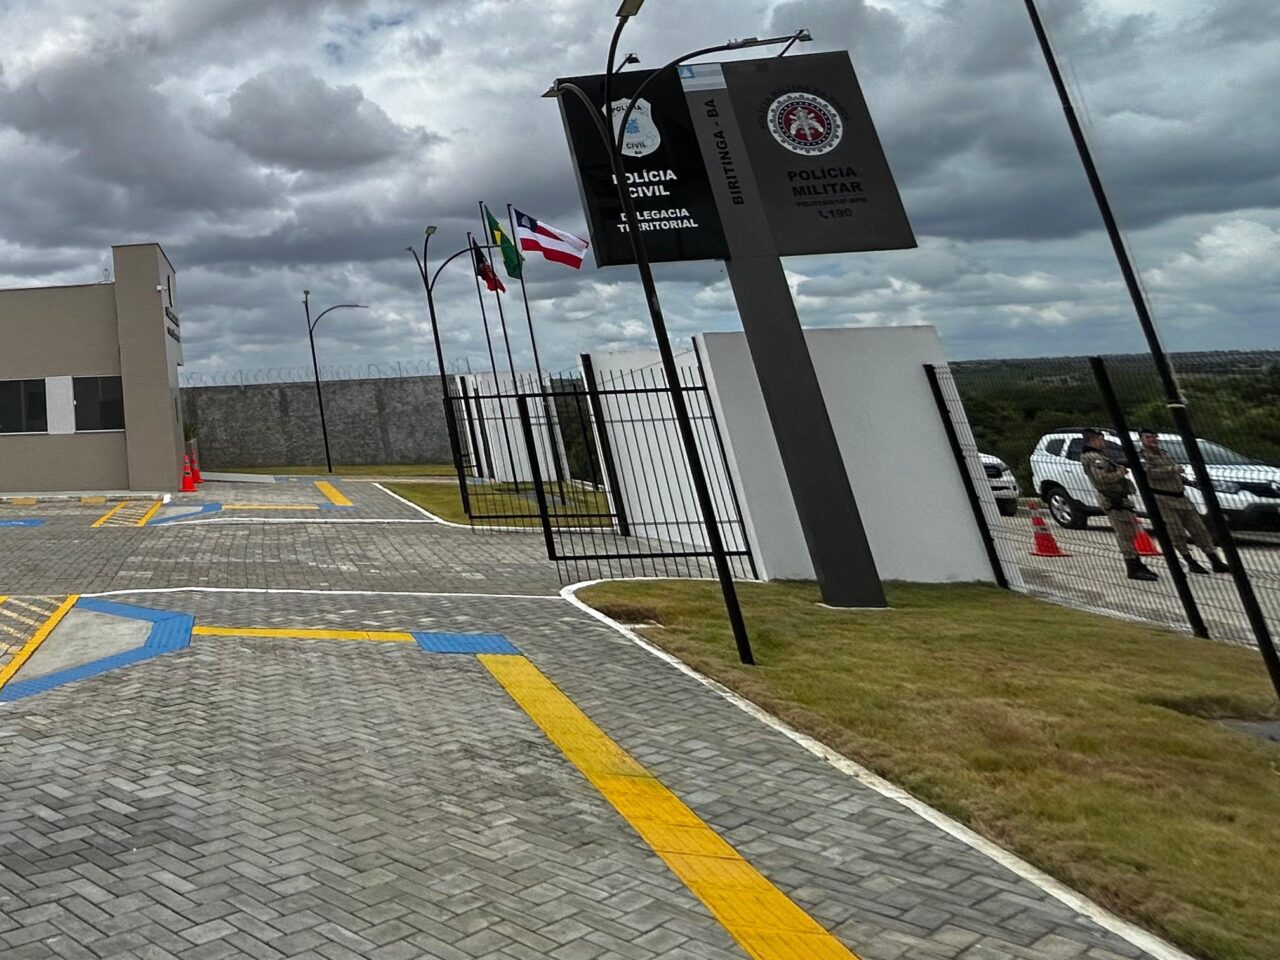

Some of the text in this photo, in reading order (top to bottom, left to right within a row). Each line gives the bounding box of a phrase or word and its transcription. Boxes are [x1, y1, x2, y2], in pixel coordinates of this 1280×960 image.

[704, 98, 719, 118] BA
[626, 141, 647, 149] CIVIL
[713, 129, 744, 205] BIRITINGA
[628, 184, 671, 198] CIVIL
[791, 181, 864, 197] MILITAR
[620, 207, 690, 222] DLEGACIA
[828, 207, 853, 218] 190
